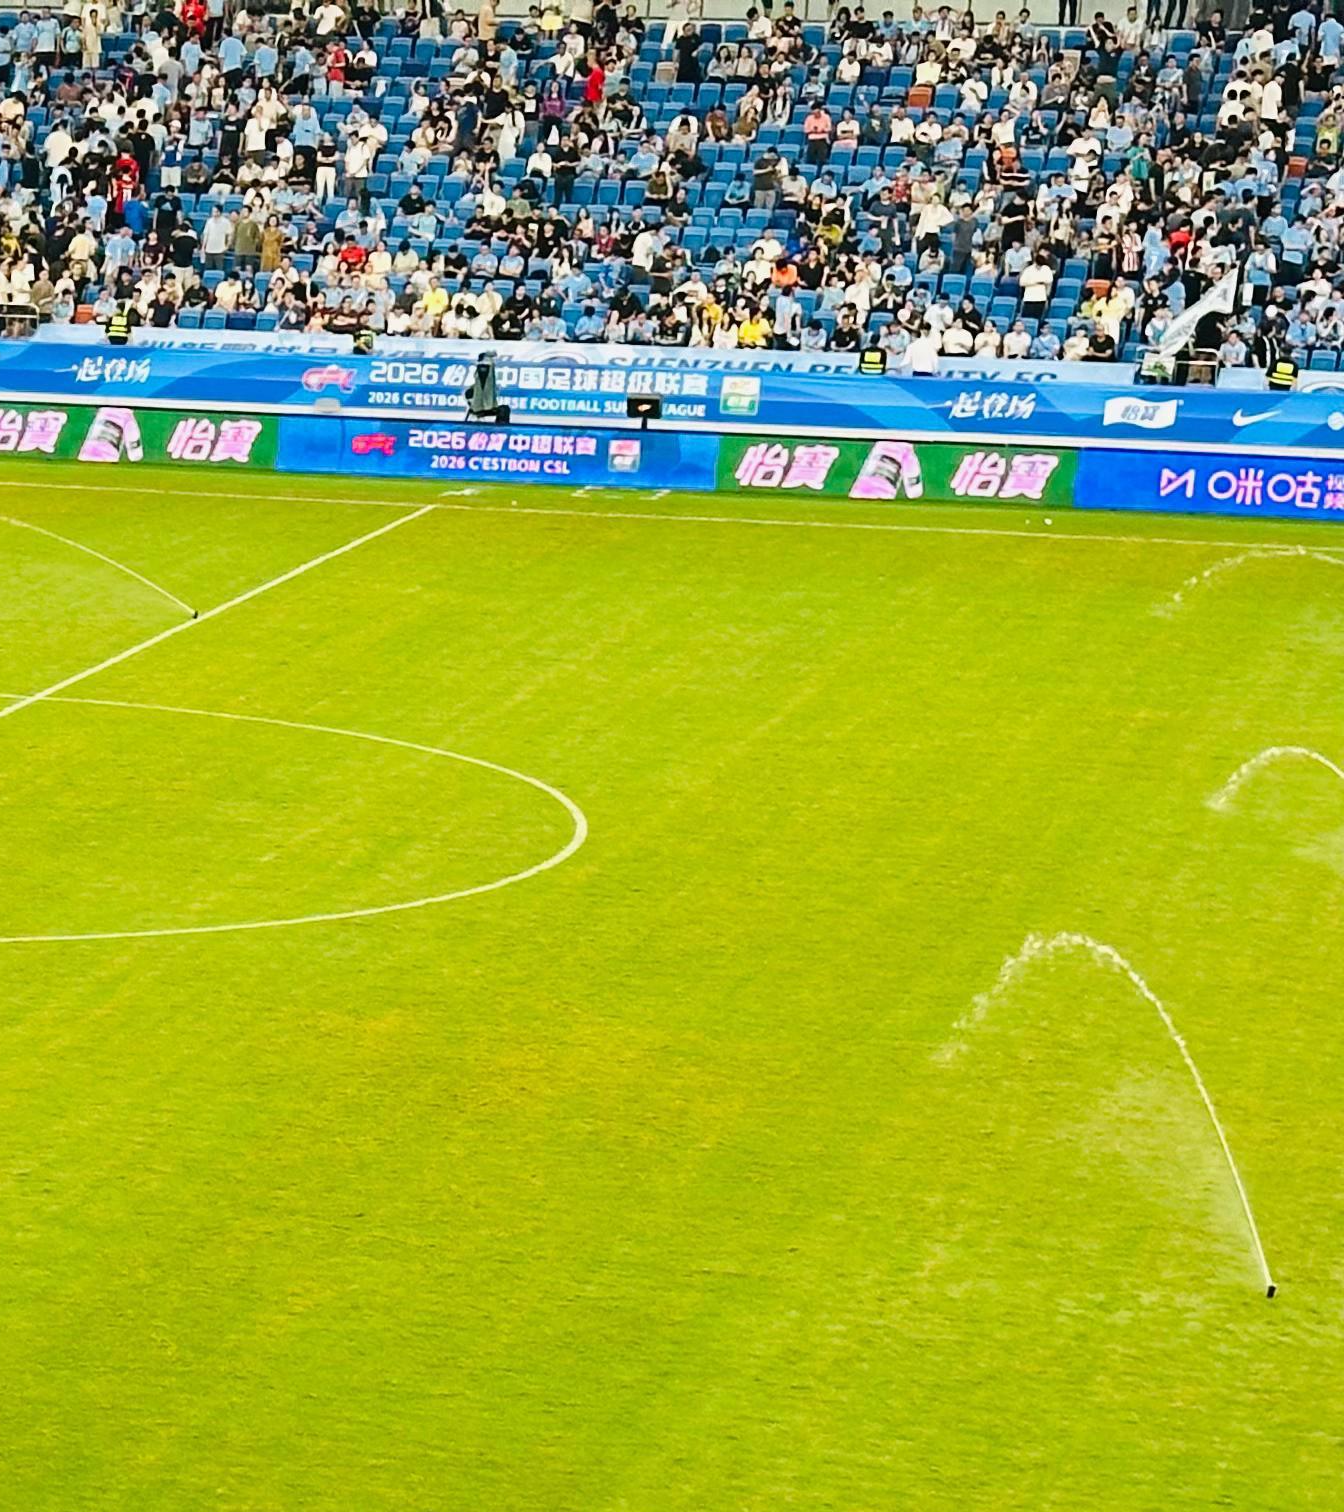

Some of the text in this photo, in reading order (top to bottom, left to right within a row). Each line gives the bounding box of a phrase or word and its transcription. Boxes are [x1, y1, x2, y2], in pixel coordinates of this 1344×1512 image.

[369, 361, 440, 385] 2026
[441, 363, 710, 397] 怡中国足球超级联赛
[368, 390, 400, 405] 2026
[529, 396, 602, 414] FOOTBALL
[166, 418, 263, 463] 怡寶
[408, 429, 466, 450] 2026
[430, 454, 571, 475] 2026 C'ESTBON CSL
[734, 442, 841, 490] 怡寶
[949, 451, 1060, 500] 怡寶
